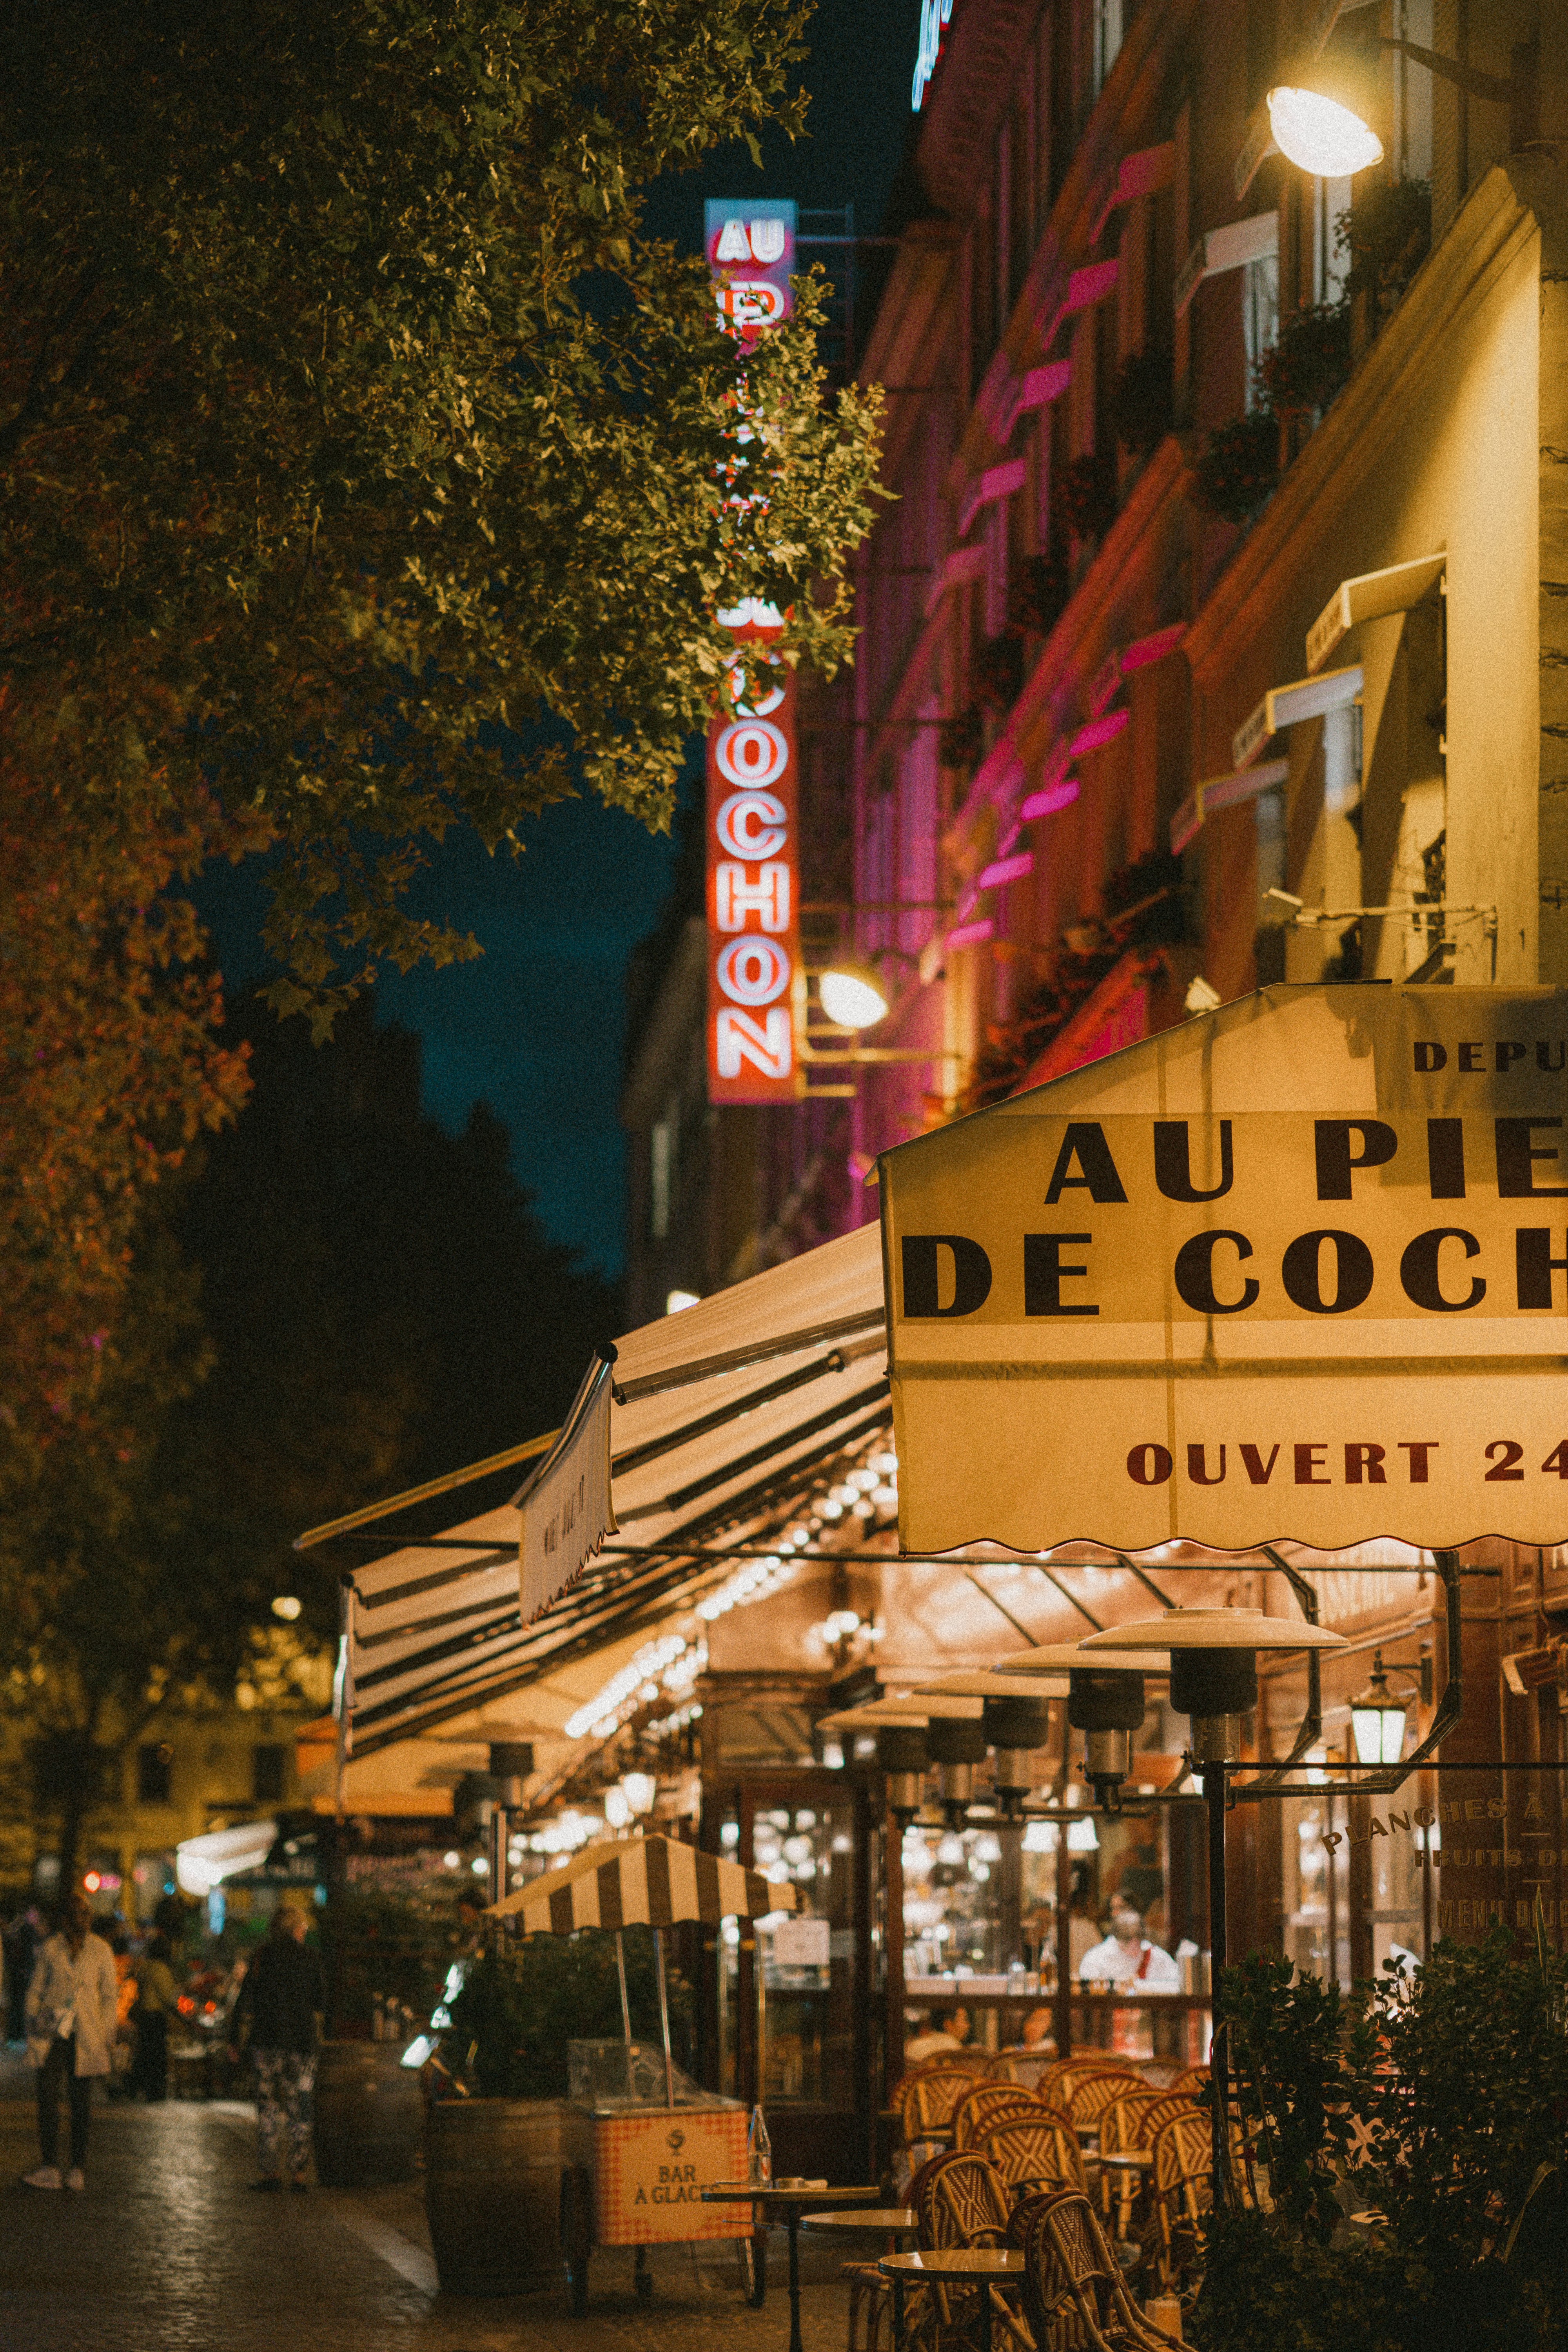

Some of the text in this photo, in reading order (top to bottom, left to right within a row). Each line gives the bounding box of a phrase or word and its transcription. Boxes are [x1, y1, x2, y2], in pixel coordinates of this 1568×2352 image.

[715, 218, 785, 263] AU
[1414, 1042, 1566, 1072] DEPU
[1044, 1116, 1568, 1205] AU PIE
[901, 1227, 1568, 1318] DE COCH
[1126, 1439, 1568, 1486] OUVERT 24
[1321, 1798, 1508, 1857] PLANCHES
[1414, 1849, 1523, 1867] FRUITS
[1437, 1900, 1504, 1928] MENU
[659, 2164, 696, 2183] BAR
[635, 2182, 648, 2204] À
